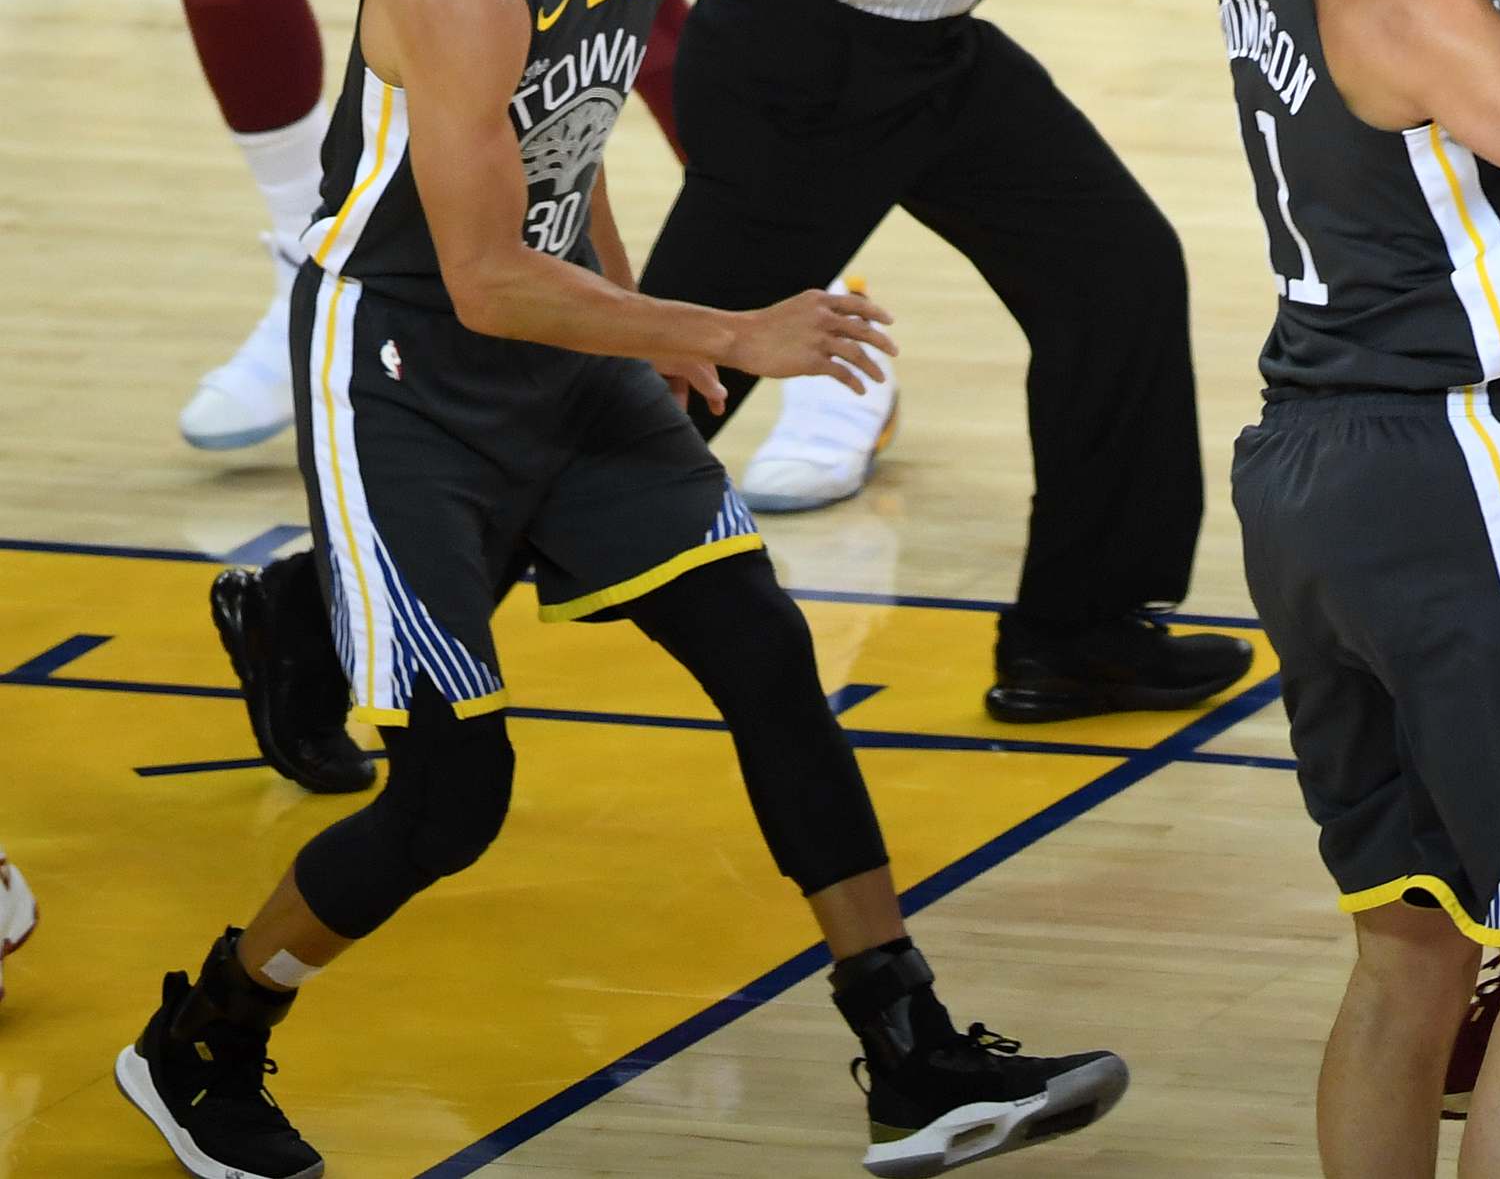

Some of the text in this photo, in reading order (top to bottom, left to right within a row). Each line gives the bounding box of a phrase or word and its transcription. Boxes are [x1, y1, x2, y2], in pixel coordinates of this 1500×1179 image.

[512, 28, 647, 130] TOWN
[522, 191, 582, 252] 30
[1255, 110, 1329, 306] 1
